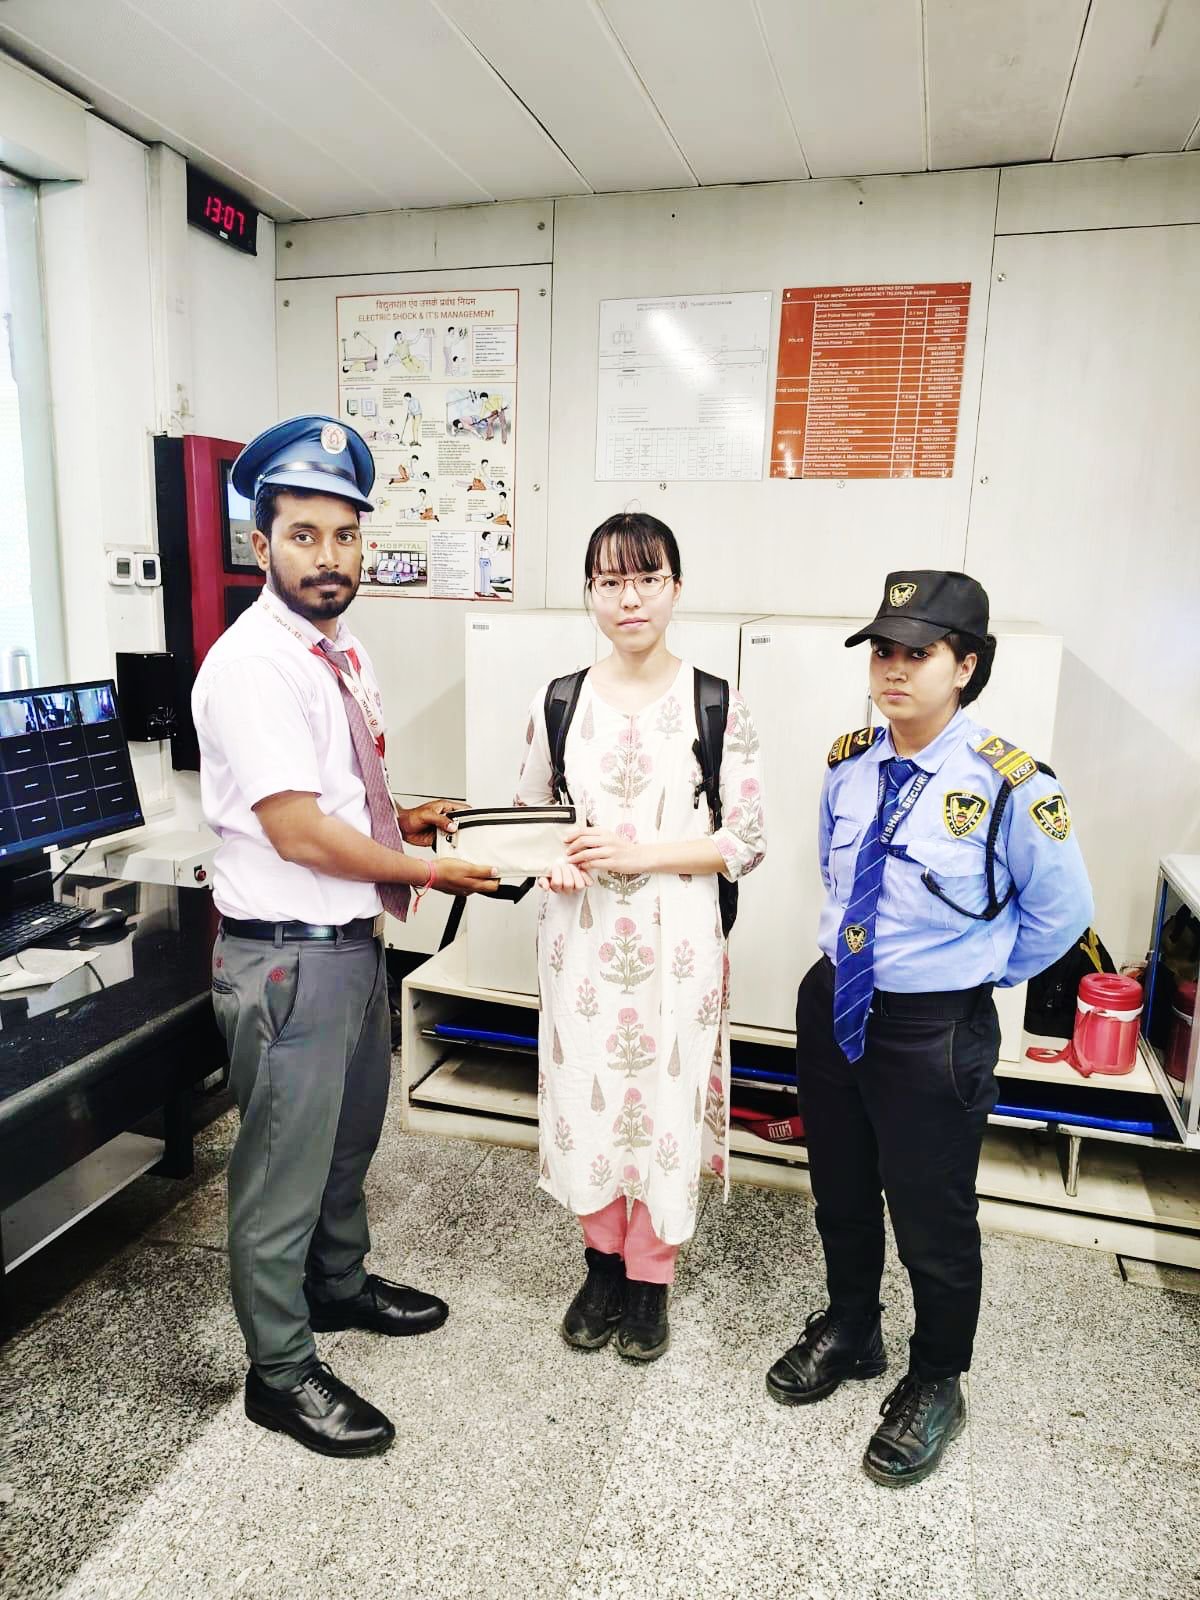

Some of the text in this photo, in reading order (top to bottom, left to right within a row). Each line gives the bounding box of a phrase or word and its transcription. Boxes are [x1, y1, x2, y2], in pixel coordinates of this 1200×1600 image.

[205, 196, 246, 236] 13:07
[358, 314, 391, 322] ELECTRIC
[392, 312, 417, 321] SHOCK
[440, 310, 494, 319] MANAGEMENT
[1012, 762, 1032, 780] VSF
[880, 809, 906, 845] VISHAL
